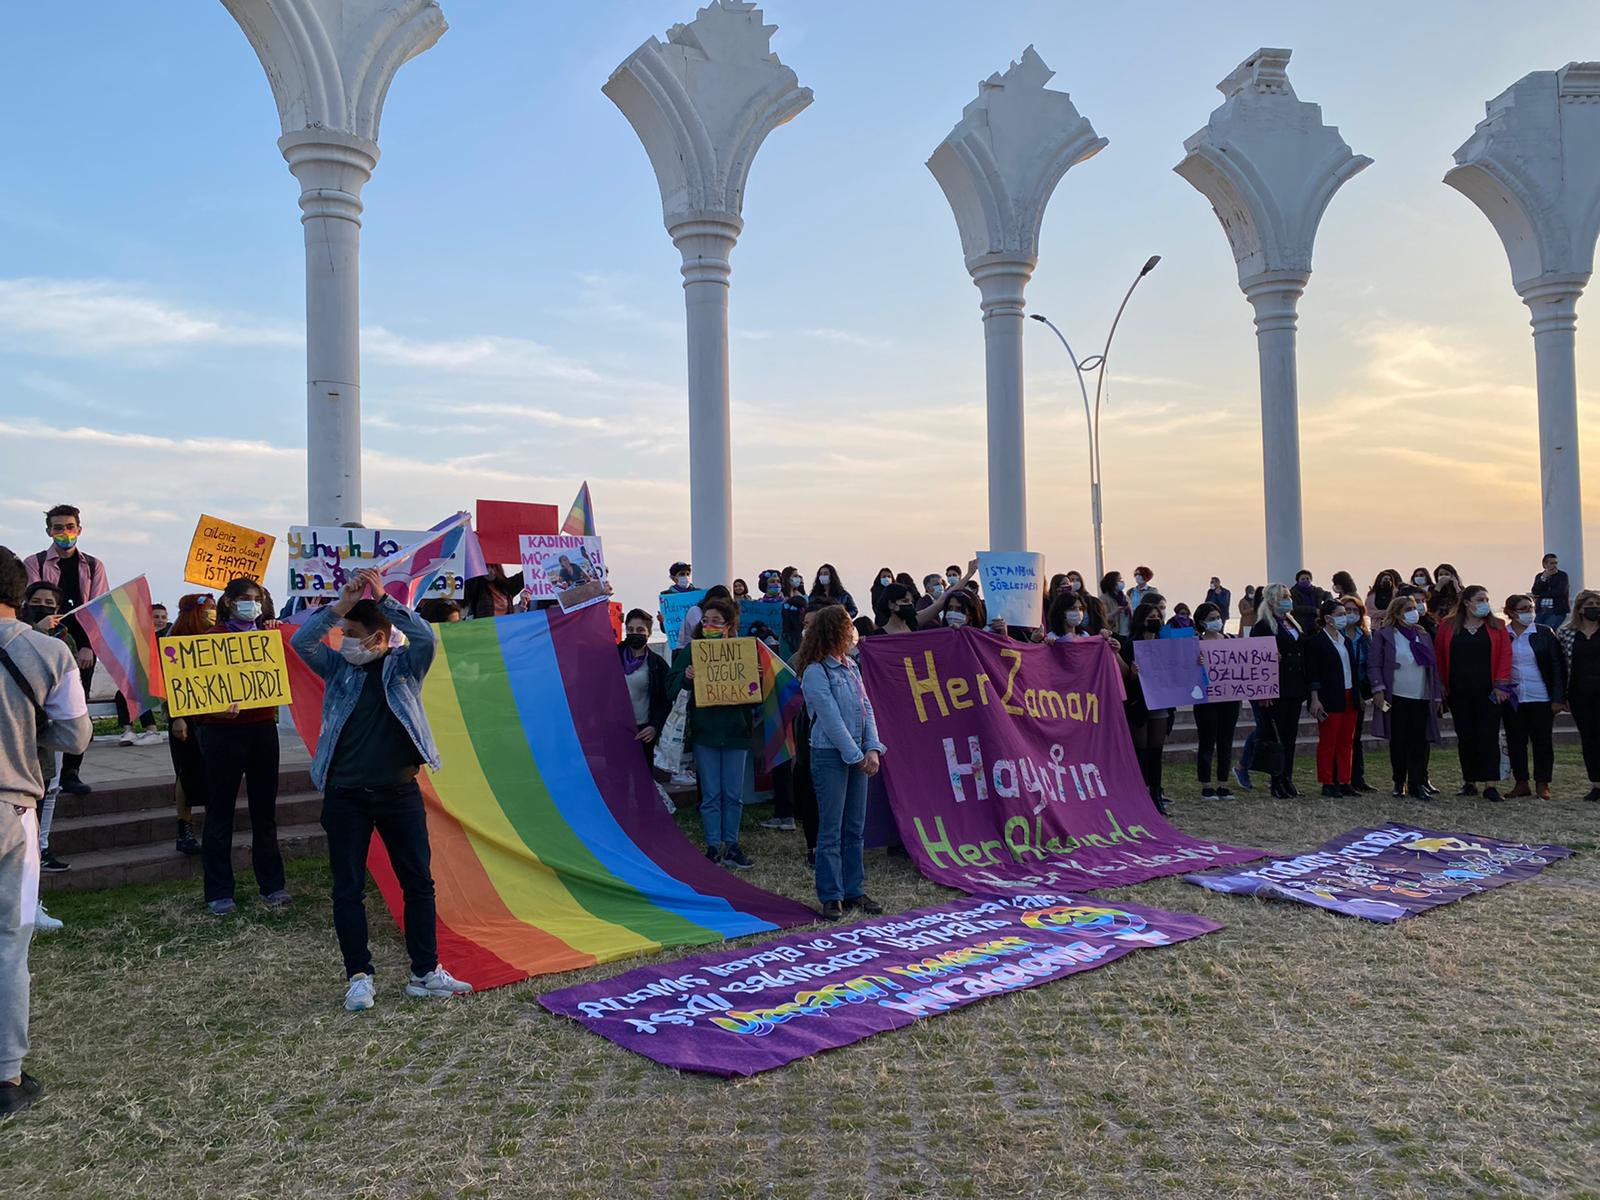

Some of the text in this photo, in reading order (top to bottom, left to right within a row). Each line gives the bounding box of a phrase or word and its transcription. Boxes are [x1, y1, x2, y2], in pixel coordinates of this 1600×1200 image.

[216, 542, 237, 553] sizin
[528, 535, 585, 548] KADININ
[218, 555, 258, 572] HAYATI
[179, 635, 275, 670] MEMELER
[904, 648, 1099, 724] Her Zaman
[913, 815, 1003, 869] Her
